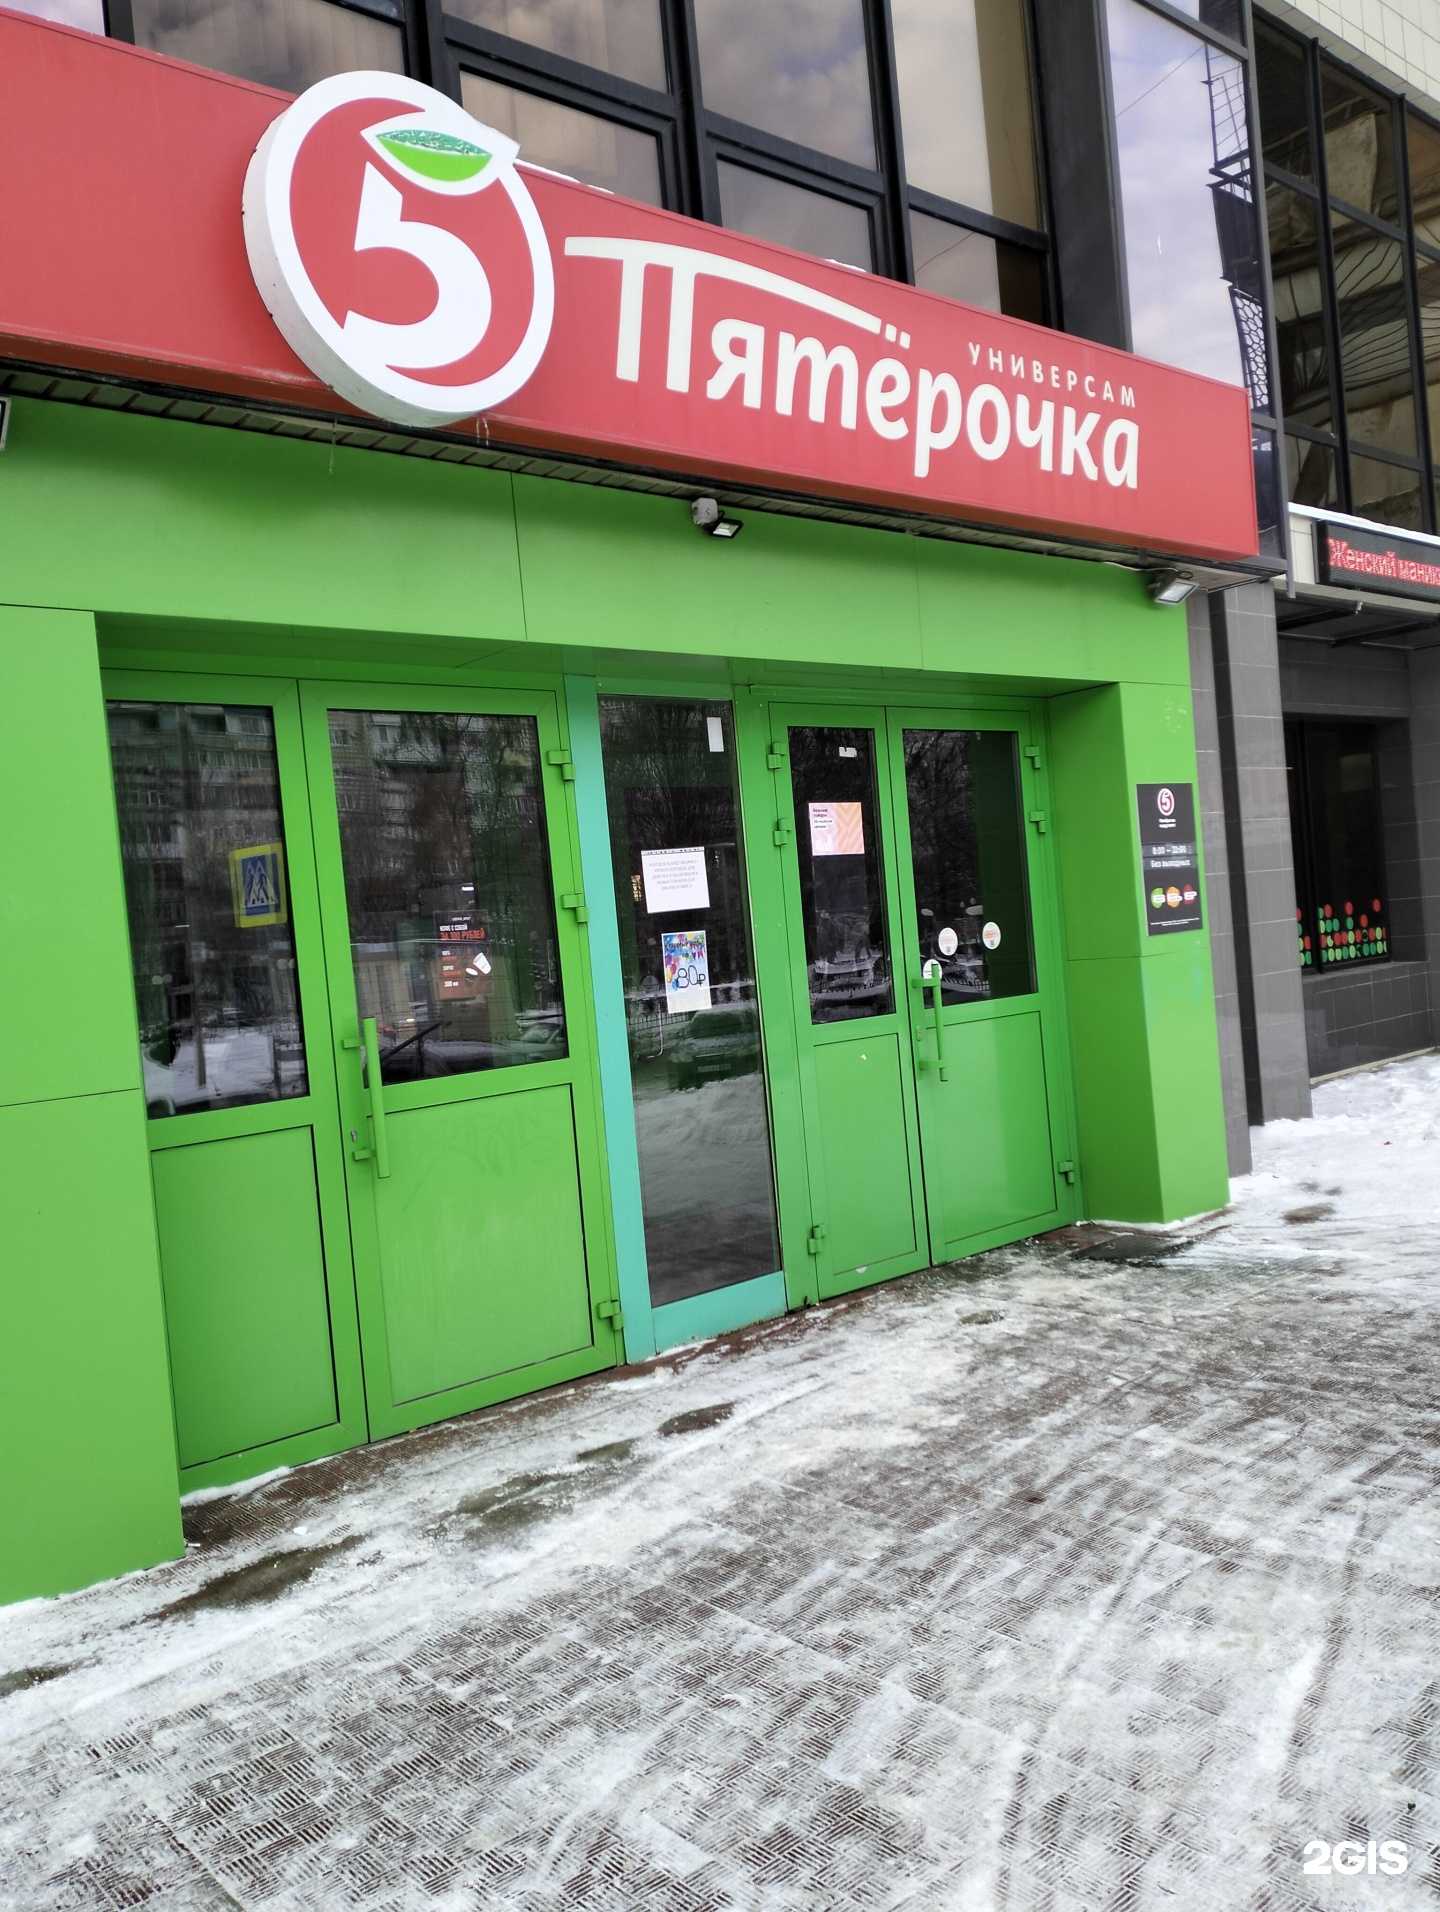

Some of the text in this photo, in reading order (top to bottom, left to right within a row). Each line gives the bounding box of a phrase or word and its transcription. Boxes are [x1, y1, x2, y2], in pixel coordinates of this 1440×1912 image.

[343, 161, 492, 369] 5
[564, 236, 1140, 490] Пятёрочка
[968, 341, 1136, 408] УНИВЕРСАМ
[1327, 538, 1398, 577] Женский
